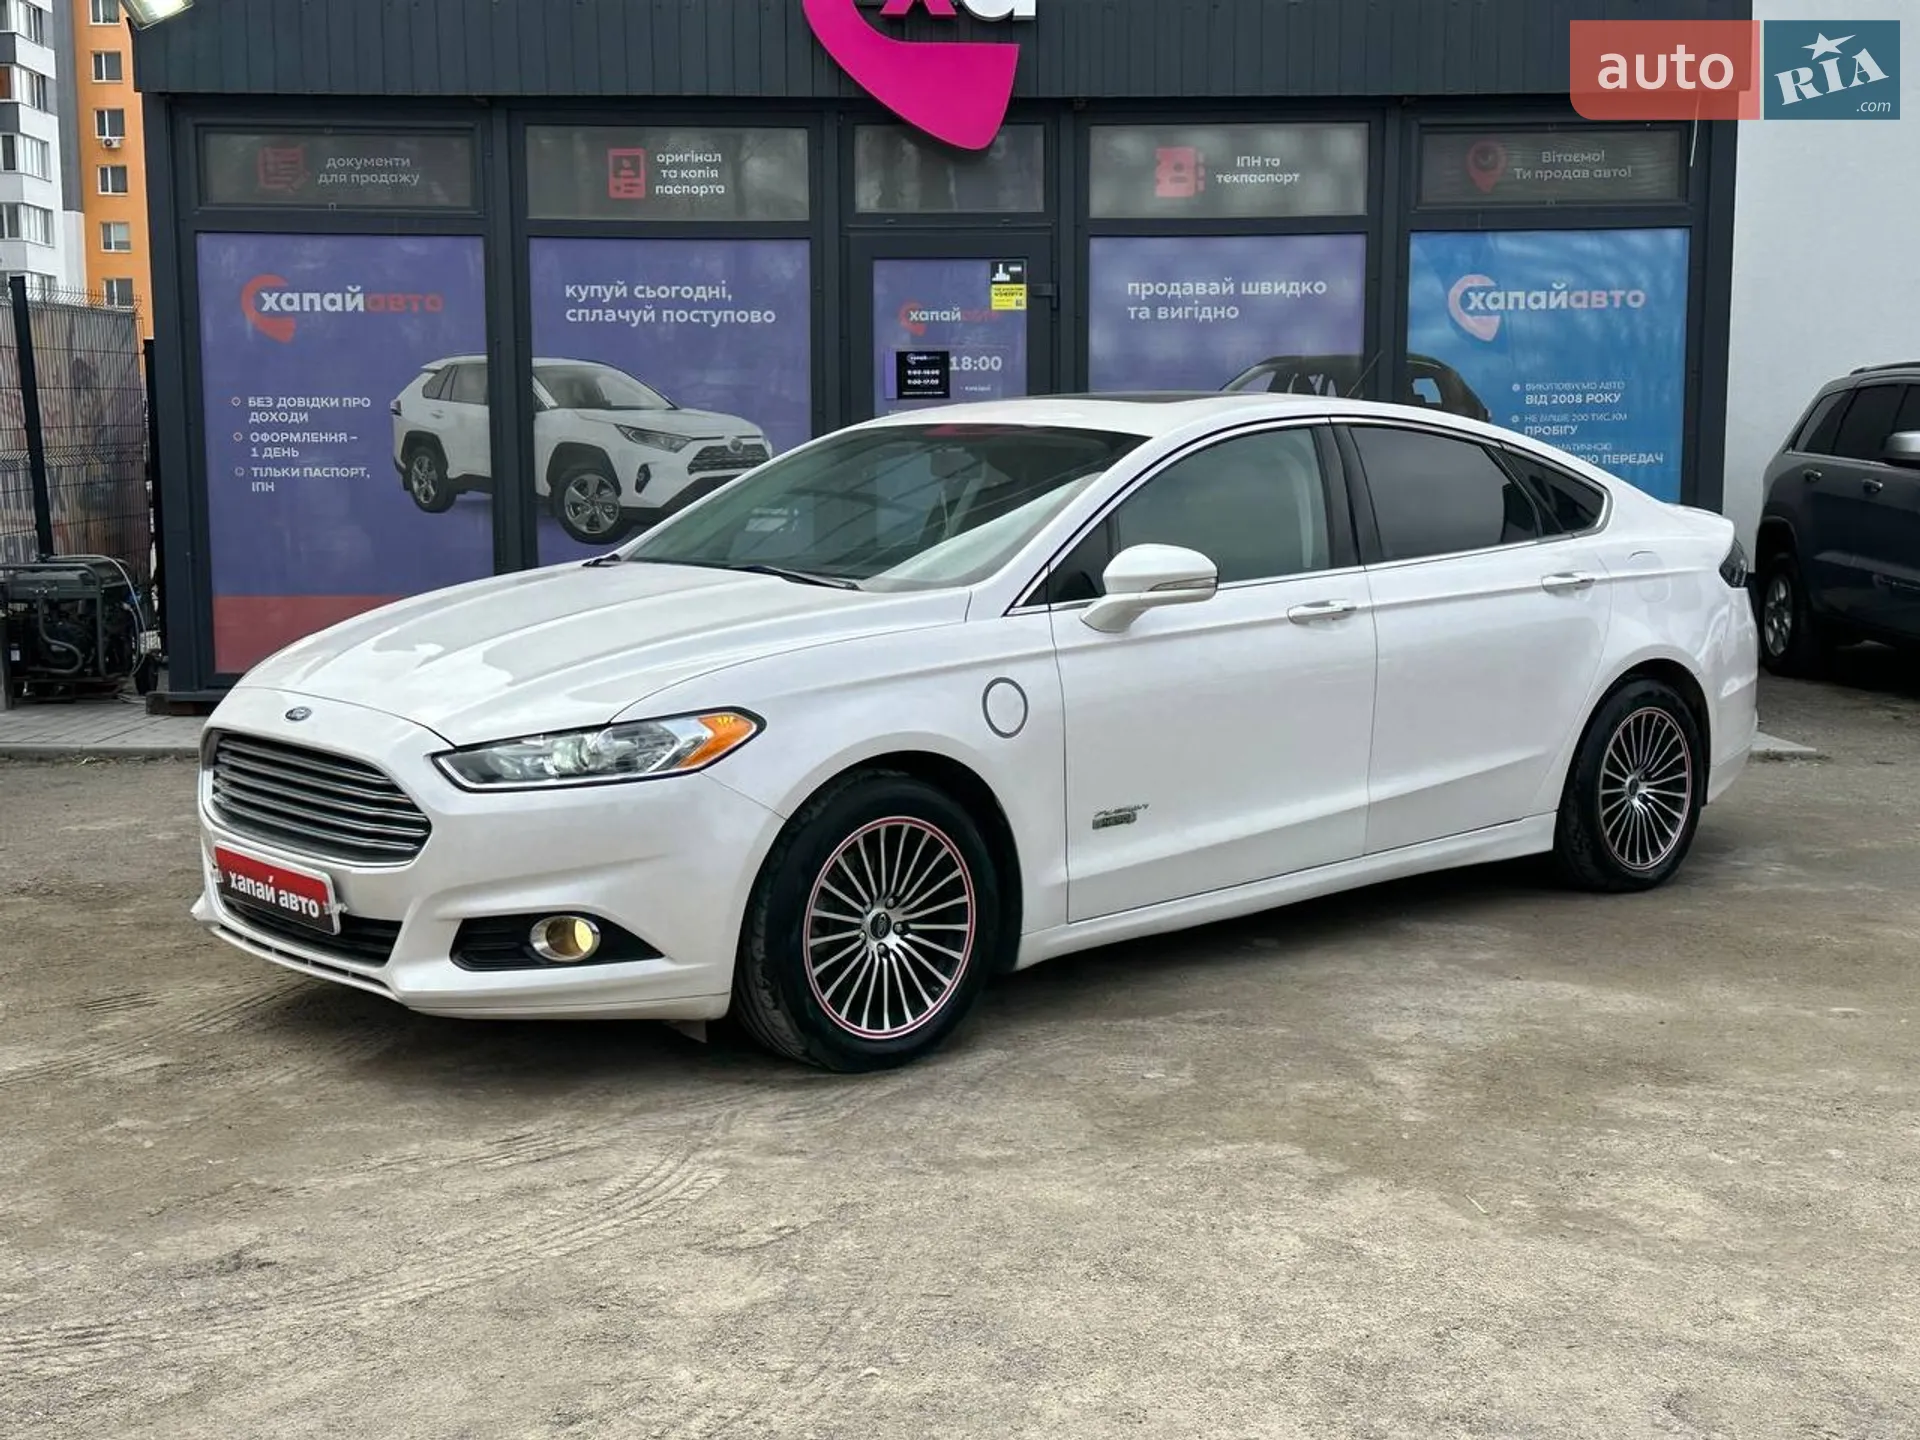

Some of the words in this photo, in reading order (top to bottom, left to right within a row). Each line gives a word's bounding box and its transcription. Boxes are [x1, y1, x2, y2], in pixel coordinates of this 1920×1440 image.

[326, 156, 411, 169] документи
[656, 150, 722, 165] оригінал
[1236, 156, 1261, 168] ІПН
[1265, 157, 1281, 168] та
[1541, 150, 1605, 163] Вітаємо!
[661, 167, 678, 179] та
[681, 166, 719, 179] копія
[1216, 172, 1300, 186] техпаспорт
[1514, 167, 1532, 180] Ти
[1535, 169, 1590, 181] продав
[1593, 166, 1632, 179] авто!
[318, 173, 347, 185] для
[351, 173, 420, 186] продажу
[655, 183, 726, 198] паспорта
[565, 280, 628, 303] купуй
[634, 279, 733, 301] сьогодні,
[1127, 276, 1235, 299] продавай
[1241, 280, 1327, 298] швидко
[260, 285, 445, 313] хапайавто
[1467, 282, 1646, 311] хапайавто
[565, 305, 656, 328] сплачуй
[662, 308, 777, 327] поступово
[1127, 306, 1151, 320] та
[1157, 300, 1240, 322] вигідно
[248, 397, 274, 408] БЕЗ
[276, 397, 340, 409] ДОВІДКИ
[342, 397, 371, 408] ПРО
[1525, 394, 1548, 406] ВІД
[1551, 394, 1583, 404] 2008
[1586, 392, 1621, 404] РОКУ
[249, 412, 309, 424] ДОХОДИ
[1524, 424, 1578, 436] ПРОБІГУ
[250, 432, 348, 443] ОФОРМЛЕННЯ
[250, 447, 259, 458] 1
[262, 447, 300, 459] ДЕНЬ
[1602, 452, 1664, 465] ПЕРЕДАЧ
[251, 466, 300, 478] ТІЛЬКИ
[303, 466, 371, 479] ПАСПОРТ,
[251, 481, 275, 492] ІПН
[229, 871, 275, 904] хапай
[279, 889, 319, 918] авто
